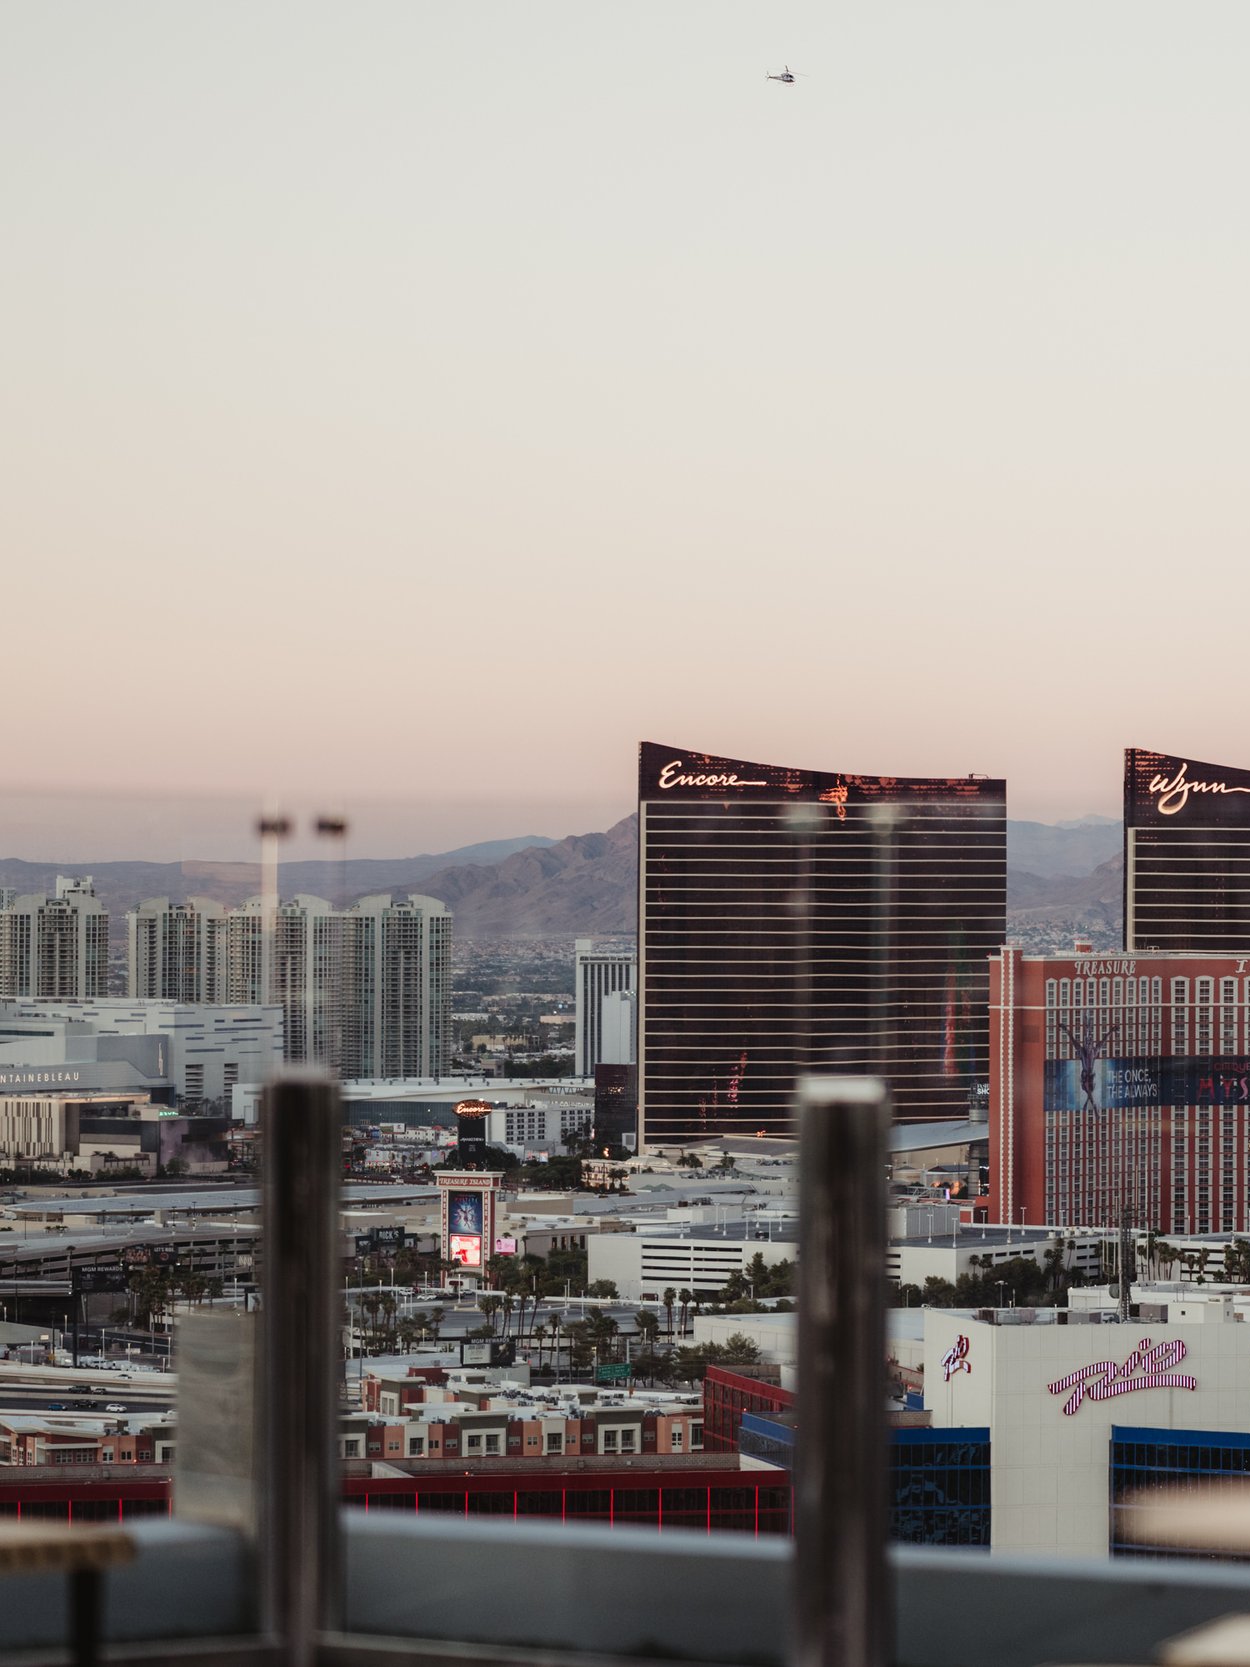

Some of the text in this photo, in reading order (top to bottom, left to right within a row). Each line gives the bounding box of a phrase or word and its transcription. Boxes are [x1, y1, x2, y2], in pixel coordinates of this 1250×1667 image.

[659, 760, 767, 788] Encore
[1074, 960, 1136, 976] TREASURE
[1214, 1062, 1250, 1073] CIRQUE
[1107, 1068, 1152, 1084] THE ONCE,
[1107, 1083, 1158, 1099] THE ALWAYS
[456, 1104, 492, 1114] Encore
[440, 1178, 468, 1186] TREASURE
[1047, 1337, 1197, 1416] Rio
